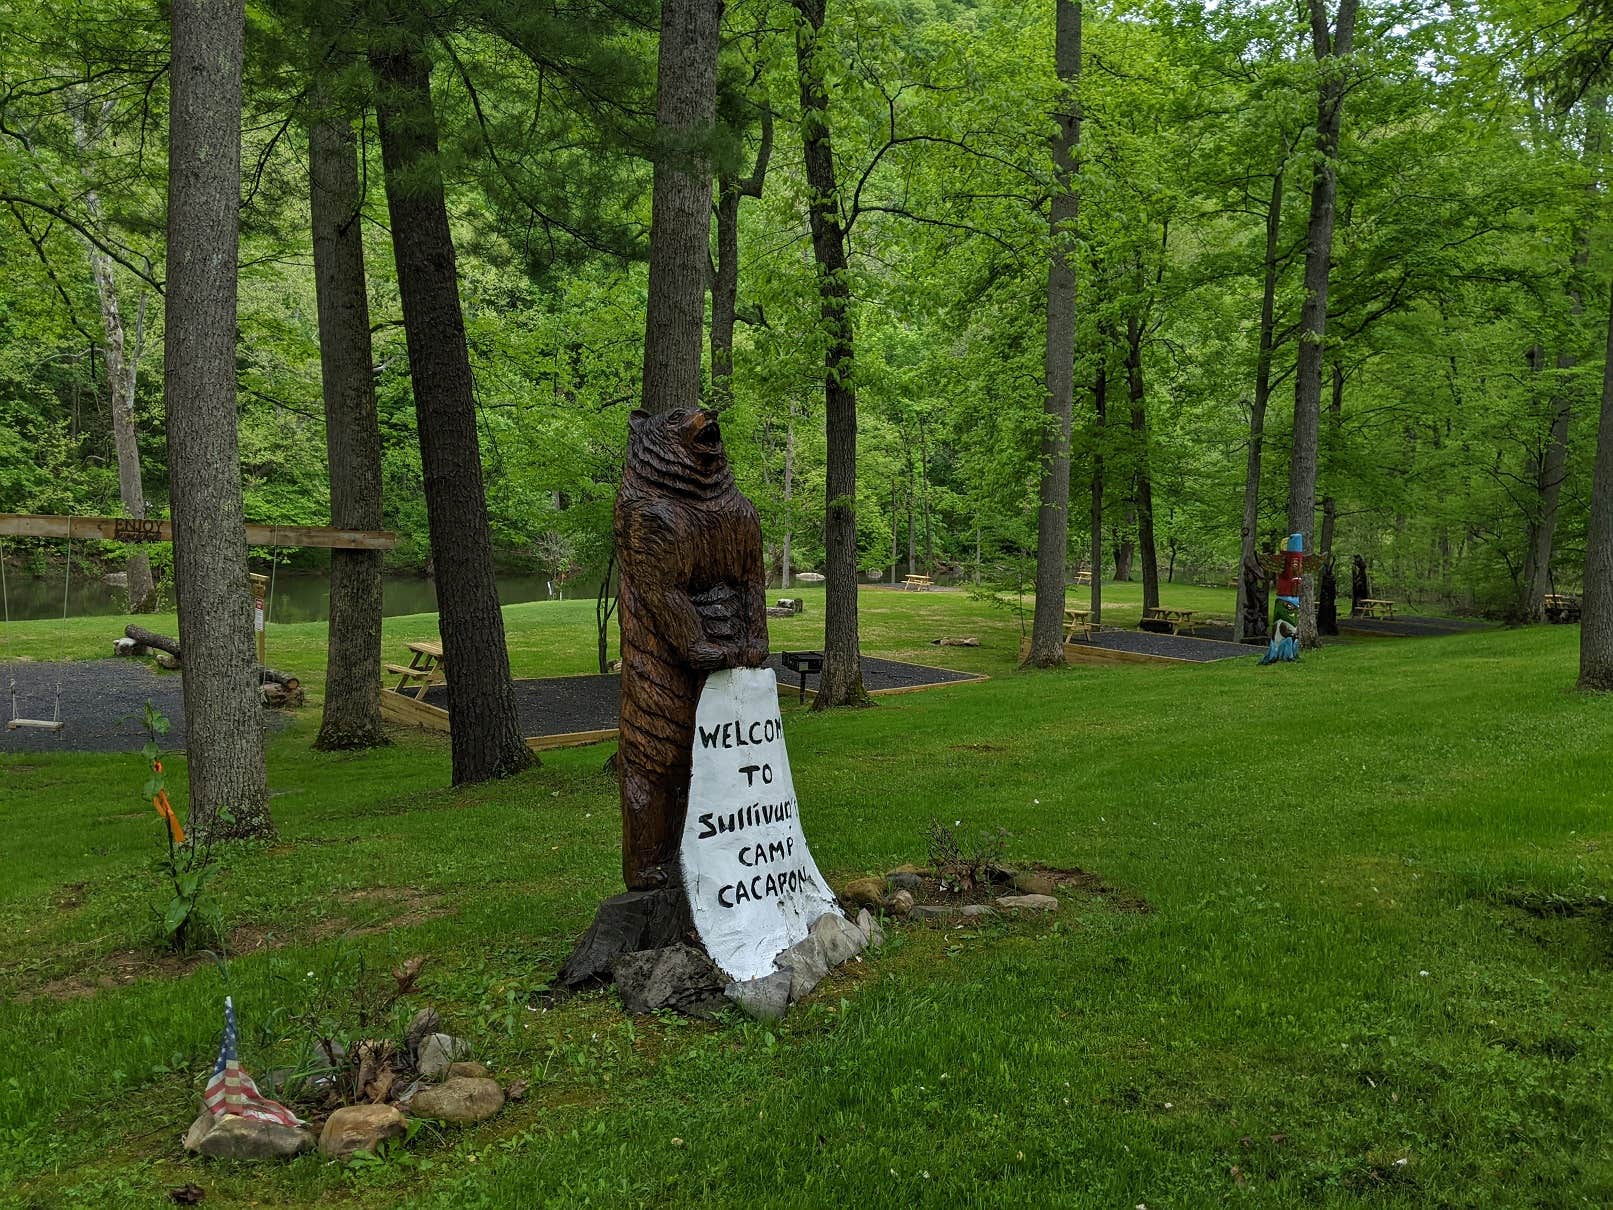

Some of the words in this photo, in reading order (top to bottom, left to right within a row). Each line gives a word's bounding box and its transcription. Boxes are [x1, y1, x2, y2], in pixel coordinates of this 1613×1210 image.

[115, 519, 163, 533] ENJOY
[738, 763, 772, 787] TO
[738, 836, 793, 866] CAMP
[718, 866, 807, 908] CACAPON
